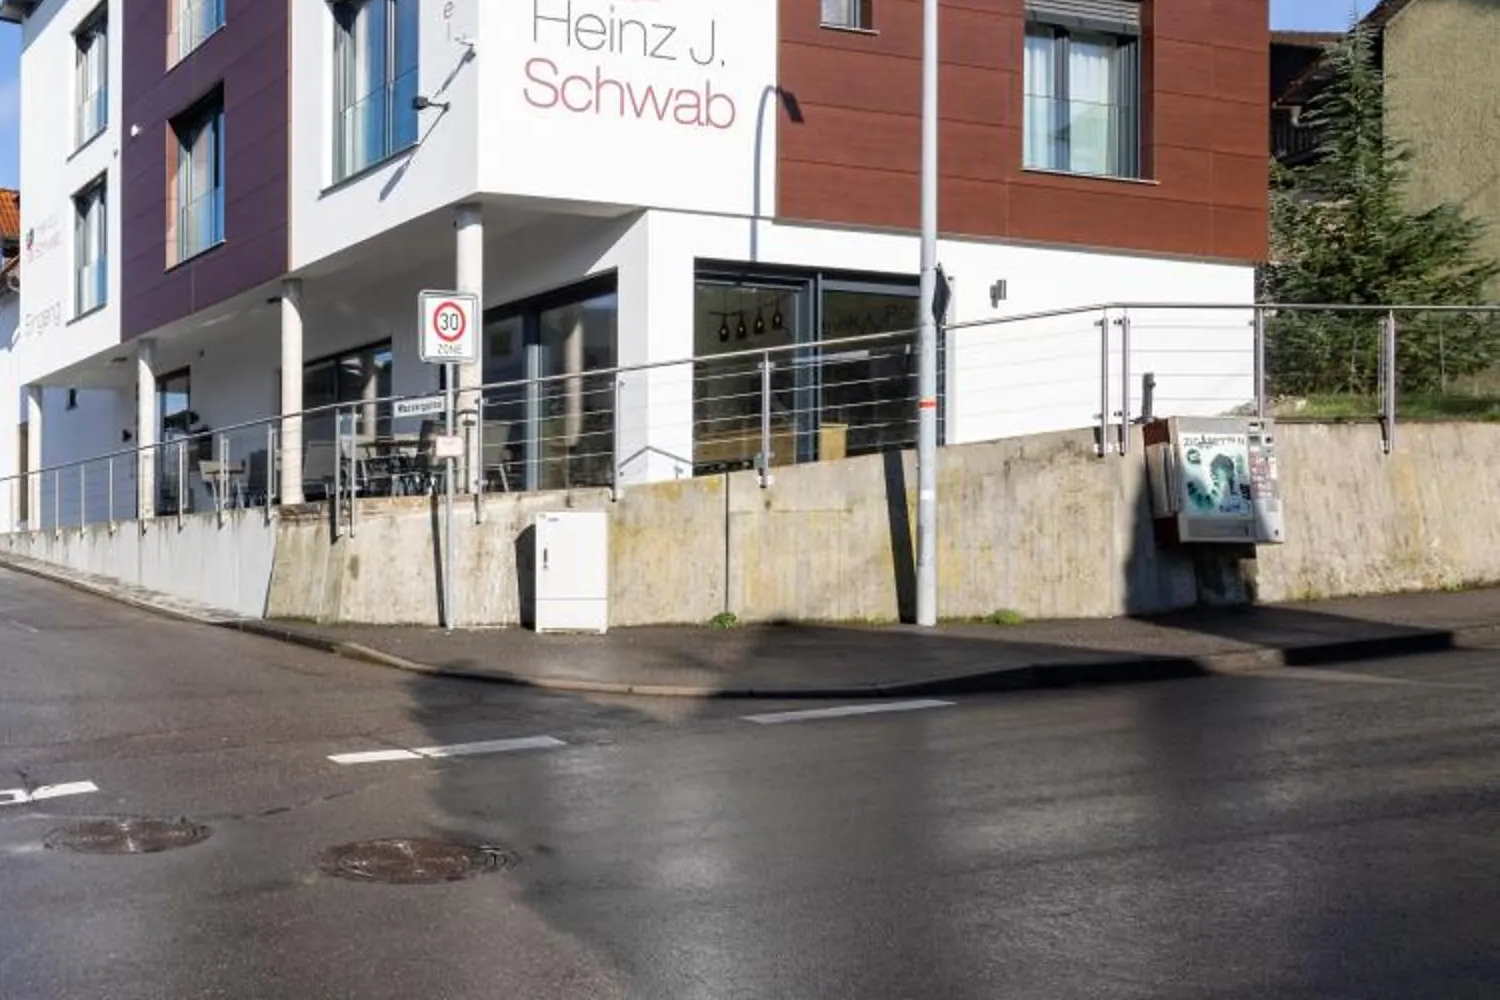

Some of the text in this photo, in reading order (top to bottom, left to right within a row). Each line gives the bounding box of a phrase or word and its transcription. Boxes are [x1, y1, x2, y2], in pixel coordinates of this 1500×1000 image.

[689, 20, 725, 67] J.
[523, 57, 736, 130] Schwab
[439, 312, 460, 332] 30
[437, 343, 463, 355] ZONE
